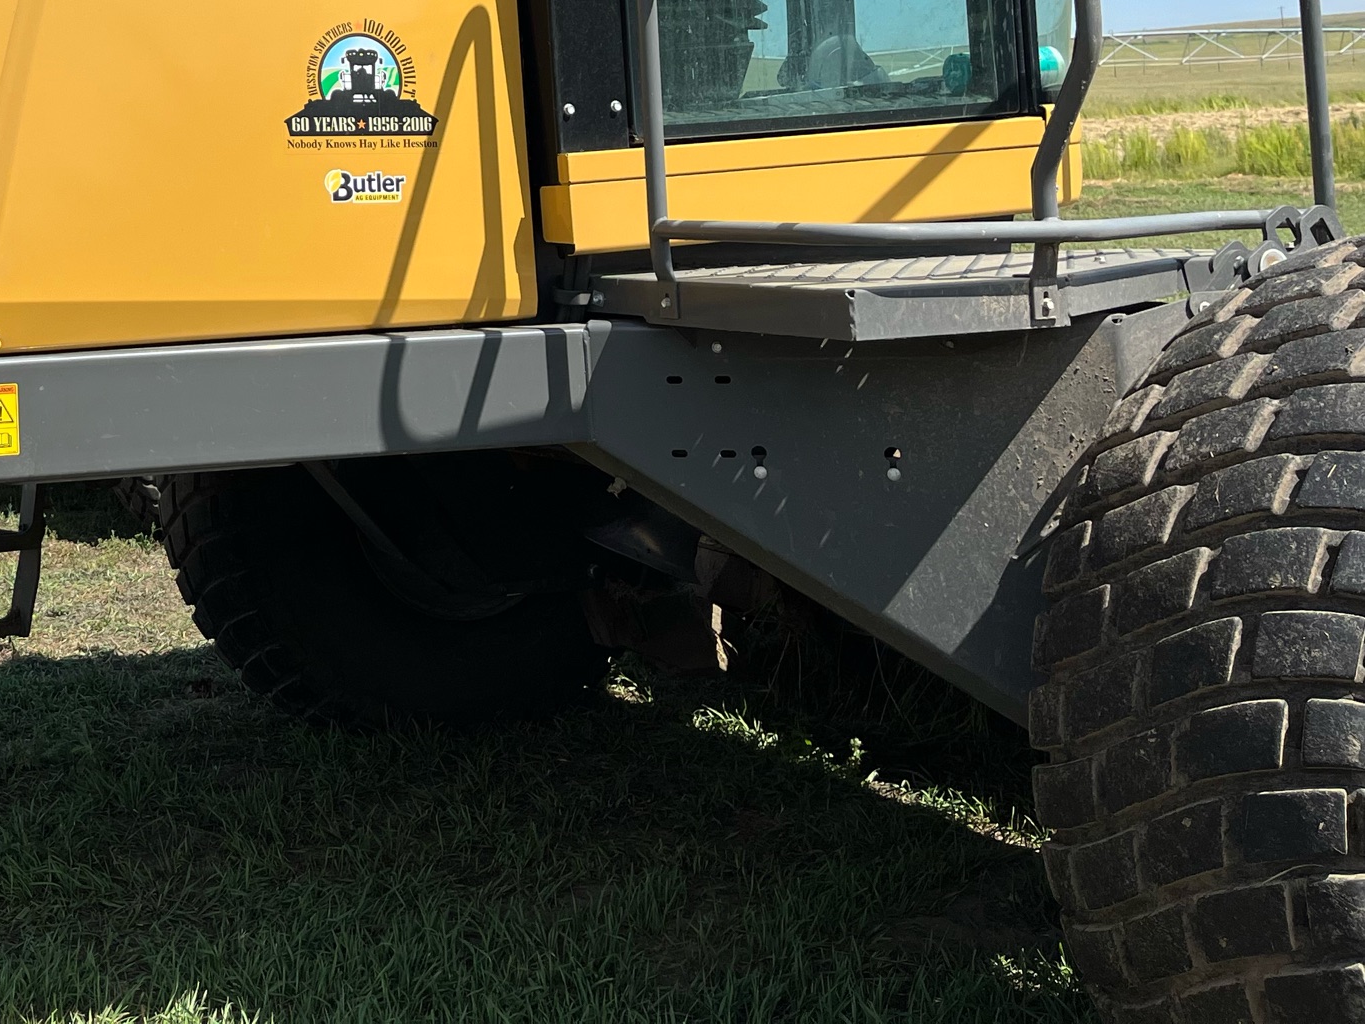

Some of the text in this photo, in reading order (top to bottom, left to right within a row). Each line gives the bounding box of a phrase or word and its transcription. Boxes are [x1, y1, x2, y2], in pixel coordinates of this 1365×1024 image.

[306, 21, 353, 96] HESSTON SWATHERS
[363, 18, 416, 98] 100,000 BUILT
[291, 116, 432, 132] 60 YEARS 1956-2016
[287, 139, 438, 150] Nobody Knows Hay Like Hesston
[333, 172, 405, 201] Butler
